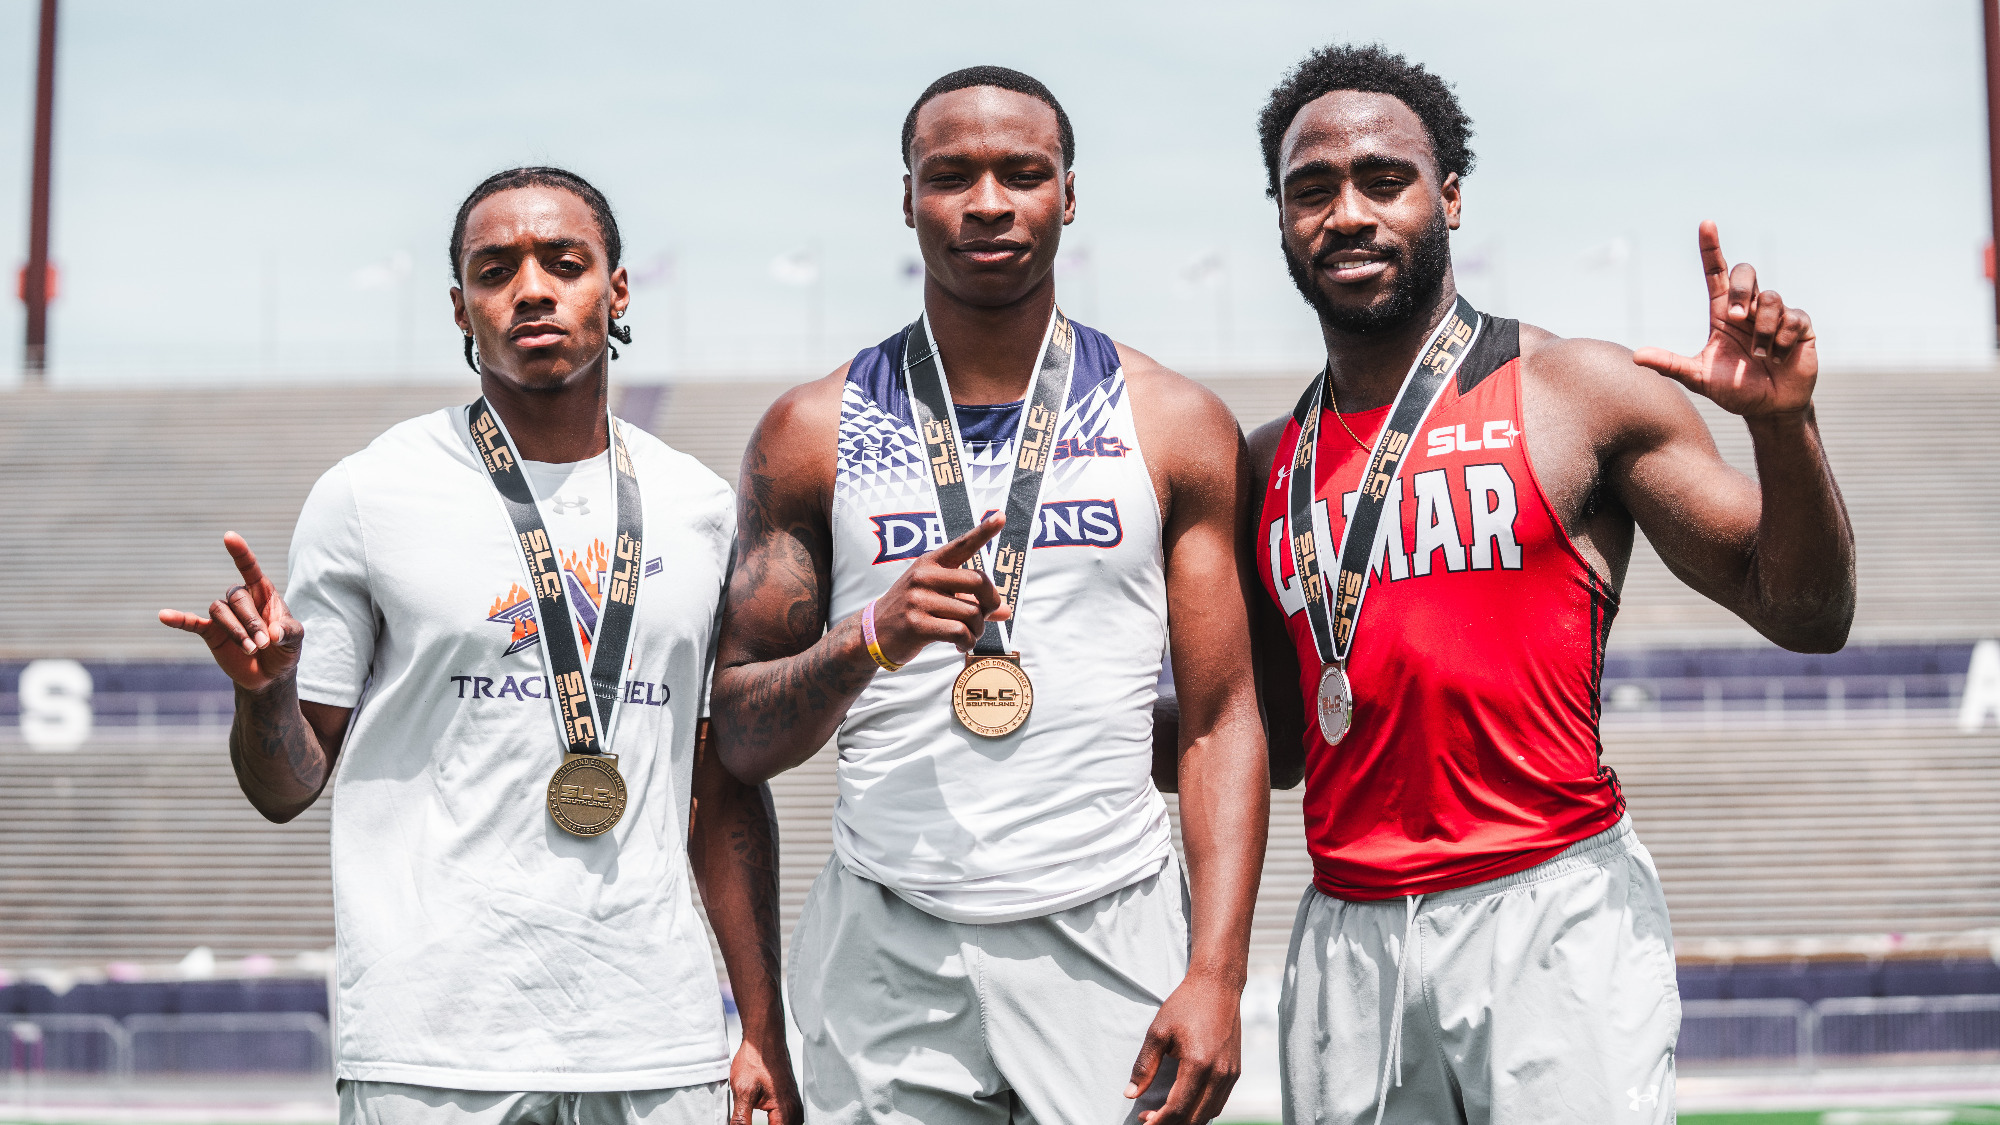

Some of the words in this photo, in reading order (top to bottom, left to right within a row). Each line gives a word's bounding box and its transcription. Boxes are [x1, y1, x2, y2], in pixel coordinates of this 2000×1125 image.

[1423, 314, 1458, 366] SOUTHLAND
[1432, 320, 1472, 374] SLC
[470, 423, 497, 474] SOUTHLAND
[476, 411, 513, 472] SLC
[924, 419, 955, 486] SLC
[943, 419, 963, 483] SOUTHLAND
[1018, 405, 1049, 472] SLC
[1036, 411, 1057, 473] SOUTHLAND
[1053, 436, 1130, 460] SLC
[1363, 430, 1392, 494] SOUTHLAND
[1373, 430, 1409, 500] SLC
[1427, 420, 1518, 457] SLC
[883, 505, 1118, 556] DENS
[519, 533, 545, 600] SOUTHLAND
[527, 529, 561, 601] SLC
[611, 533, 634, 605] SLC
[628, 541, 642, 606] SOUTHLAND
[996, 544, 1017, 604] LC
[1294, 537, 1311, 604] SOUTHLAND
[1299, 531, 1322, 602] SLC
[1338, 571, 1362, 646] SLC
[19, 659, 93, 749] S
[623, 680, 671, 708] IELD
[957, 661, 991, 689] SOUTHLAND
[992, 661, 1028, 689] CONFERENCE
[966, 689, 1018, 701] SLC
[556, 675, 576, 744] SOUTHLAND
[563, 670, 594, 746] SLC
[554, 758, 588, 784] SOUTHLAND
[560, 785, 614, 802] SLC
